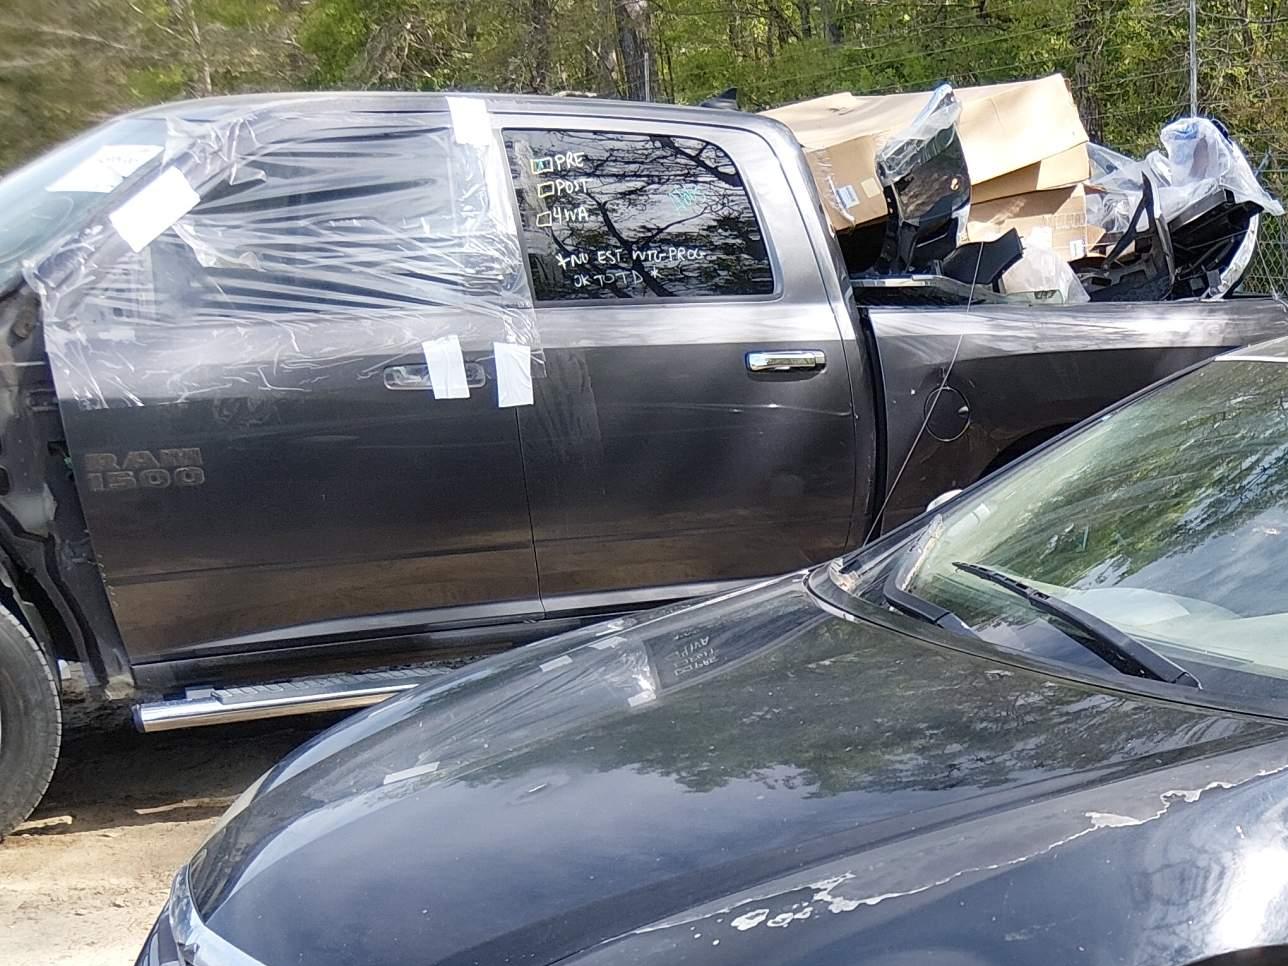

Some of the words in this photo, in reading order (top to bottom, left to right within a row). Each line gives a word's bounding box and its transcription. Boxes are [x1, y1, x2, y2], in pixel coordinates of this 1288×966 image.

[554, 151, 585, 171] PRE
[556, 179, 593, 196] POST
[84, 447, 203, 470] RAM
[86, 466, 205, 492] 1500
